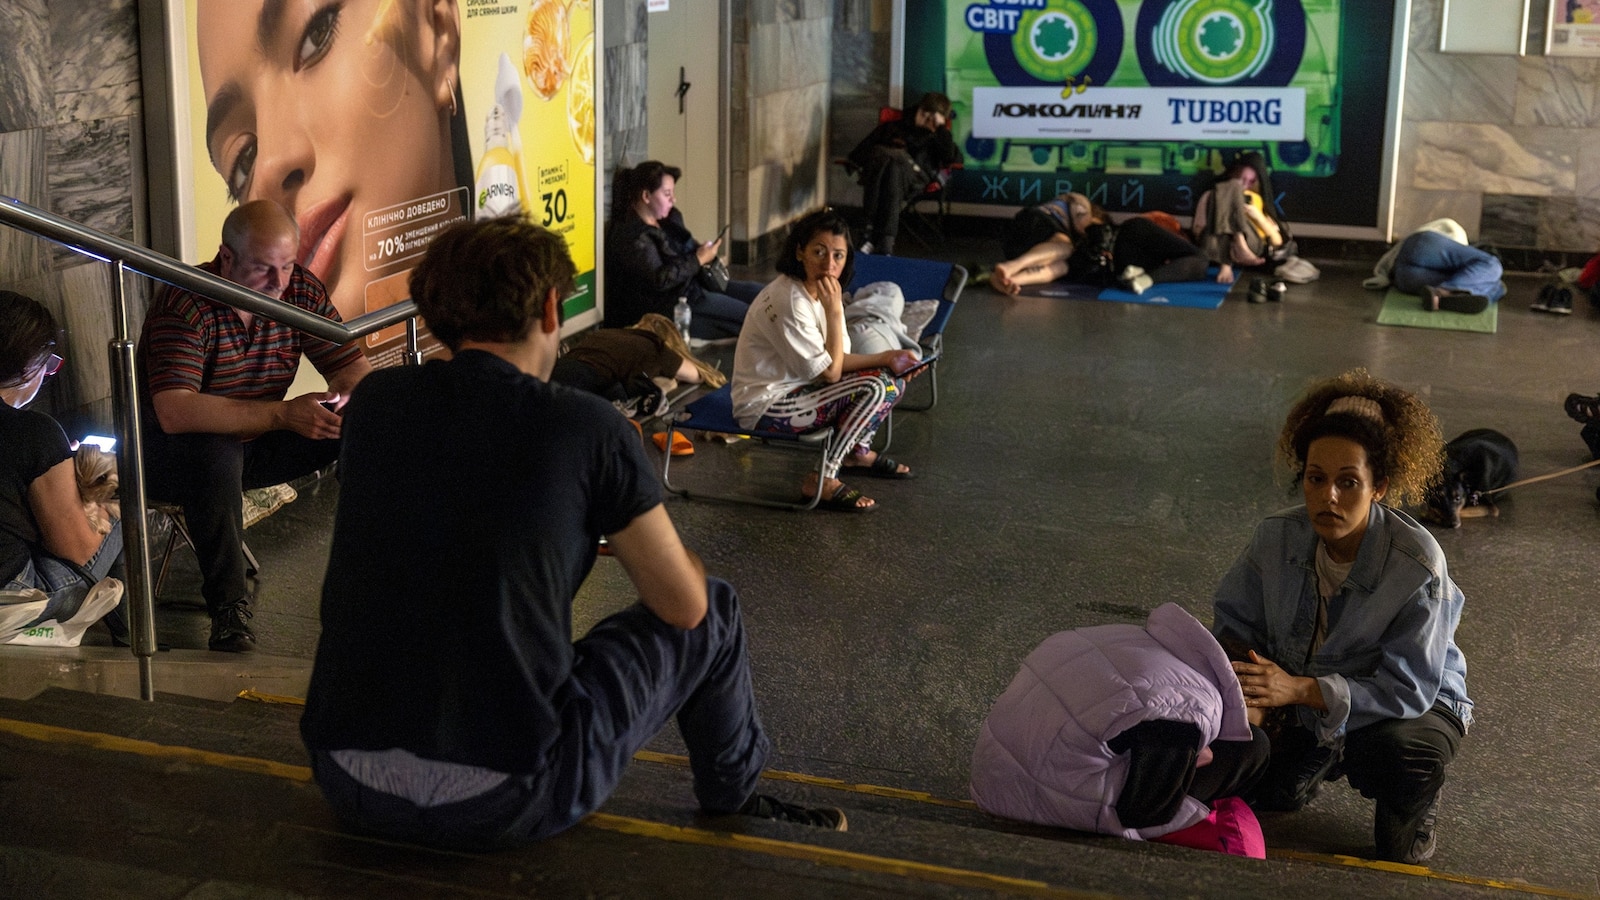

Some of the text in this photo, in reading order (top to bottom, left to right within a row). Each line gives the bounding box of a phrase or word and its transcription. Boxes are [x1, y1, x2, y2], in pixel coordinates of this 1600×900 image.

[967, 6, 1020, 31] СВІТ
[1168, 97, 1282, 125] TUBORG
[981, 174, 1145, 208] ЖИВИЙ
[368, 198, 447, 228] КЛІНІЧНО ДОВЕДЕНО
[542, 188, 567, 228] 30
[377, 234, 405, 260] 70%
